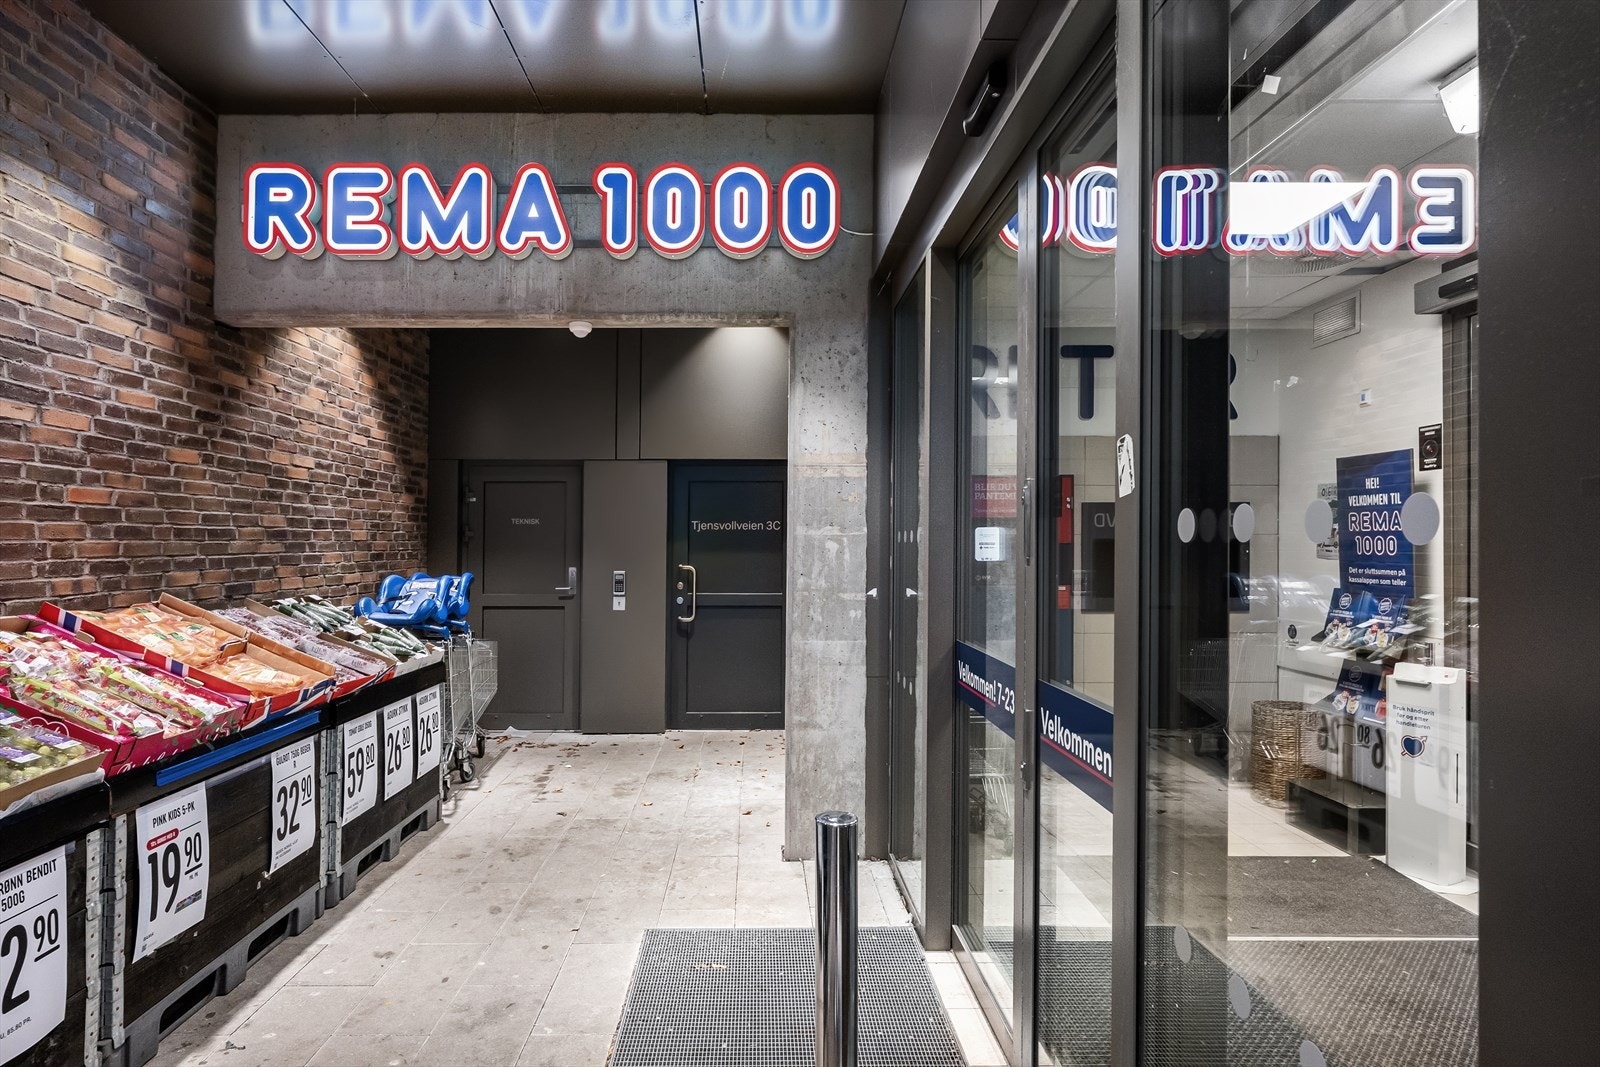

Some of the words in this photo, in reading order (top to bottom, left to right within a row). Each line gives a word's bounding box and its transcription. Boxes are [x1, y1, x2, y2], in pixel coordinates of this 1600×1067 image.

[243, 162, 573, 258] REMA
[592, 162, 840, 259] 1000
[1365, 477, 1380, 489] HEI!
[1348, 493, 1388, 507] VELKOMMEN
[1390, 492, 1402, 504] TIL
[691, 520, 764, 532] Tjensvollveien
[766, 520, 781, 531] 3C
[1348, 511, 1403, 531] REMA
[1356, 535, 1398, 555] 1000
[1349, 566, 1358, 574] Det
[1364, 567, 1397, 575] sluttsummen
[1398, 568, 1406, 577] på
[1349, 576, 1380, 585] kassalappen
[1391, 578, 1407, 586] teller
[958, 660, 997, 702] Velkommen!
[997, 683, 1015, 714] 7-23
[1406, 706, 1435, 716] håndsprit
[419, 714, 432, 756] 26
[432, 711, 439, 730] 80
[1040, 707, 1112, 777] Velkommen
[387, 730, 401, 776] 26
[402, 726, 410, 746] 80
[347, 746, 364, 798] 59
[365, 743, 375, 765] 80
[152, 813, 167, 828] PINK
[168, 807, 181, 821] KIDS
[181, 801, 195, 815] 5-PK
[276, 779, 300, 841] 32
[301, 774, 312, 800] 90
[26, 858, 57, 884] BENDIT
[148, 842, 181, 923] 19
[184, 831, 202, 868] 90
[1, 890, 25, 912] 500G
[0, 923, 30, 1015] 2
[33, 908, 60, 953] 90
